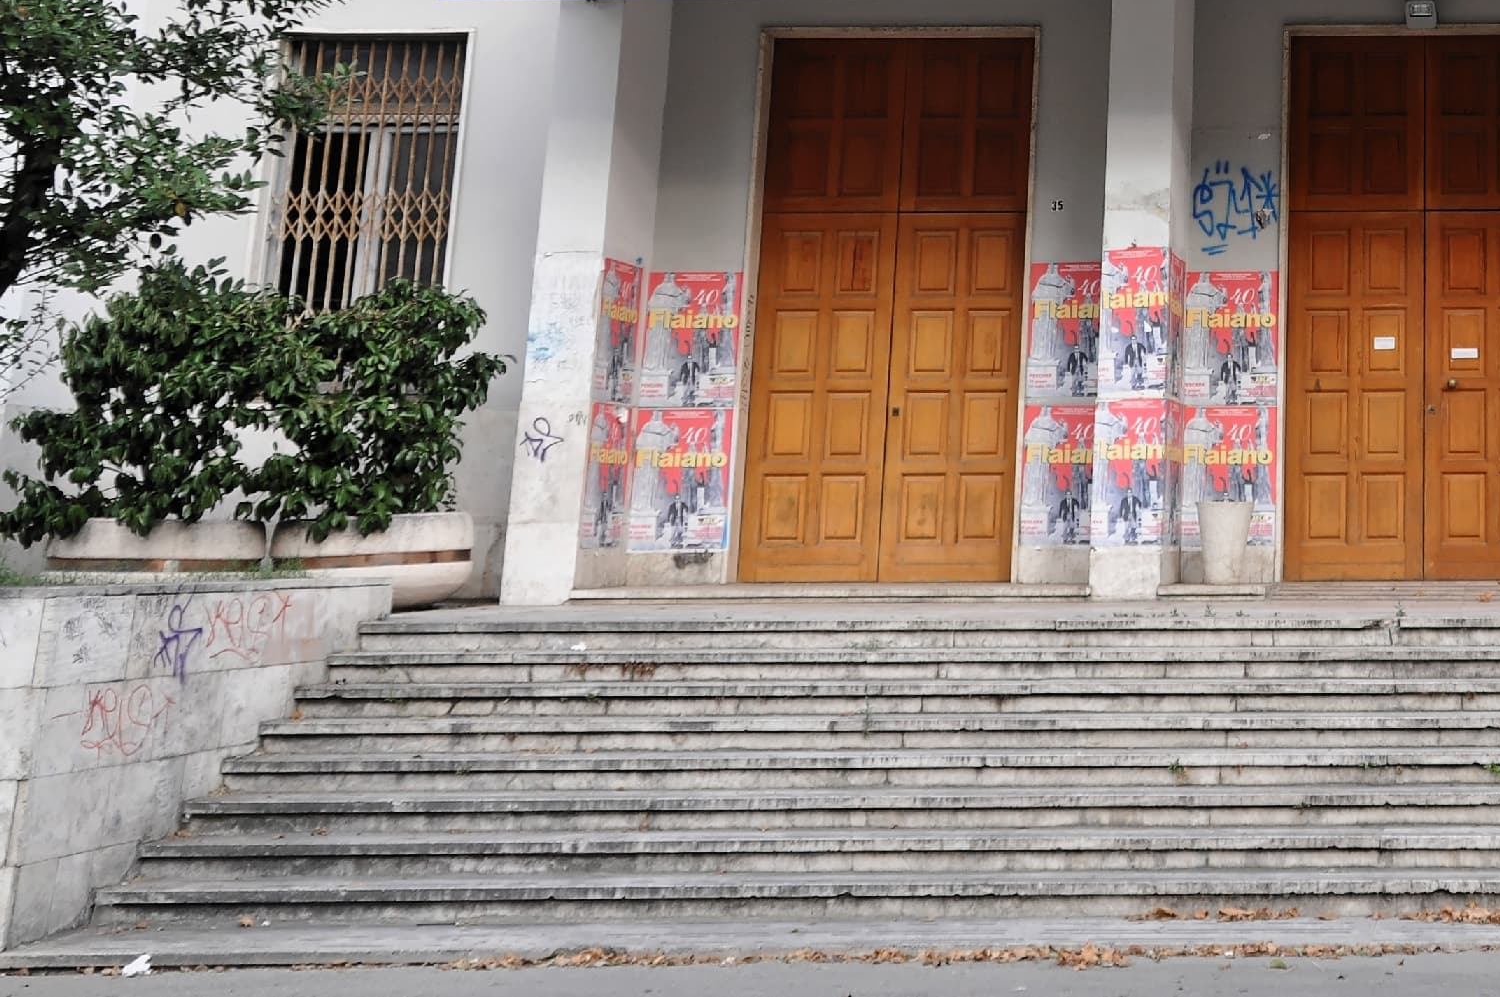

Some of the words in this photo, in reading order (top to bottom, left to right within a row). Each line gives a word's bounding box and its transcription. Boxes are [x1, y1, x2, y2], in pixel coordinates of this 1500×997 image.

[1051, 200, 1064, 211] 35
[1131, 265, 1157, 284] 40
[694, 289, 720, 305] 40
[1230, 288, 1255, 305] 40
[648, 308, 739, 329] Flaiano
[1034, 299, 1099, 319] Flaia
[1186, 308, 1276, 328] Flaiano
[1130, 416, 1157, 435] 40
[1227, 424, 1252, 441] 40
[681, 427, 708, 444] 40
[635, 446, 728, 468] Flaiano
[1027, 444, 1093, 464] Flaia
[1183, 444, 1273, 465] Flaiano
